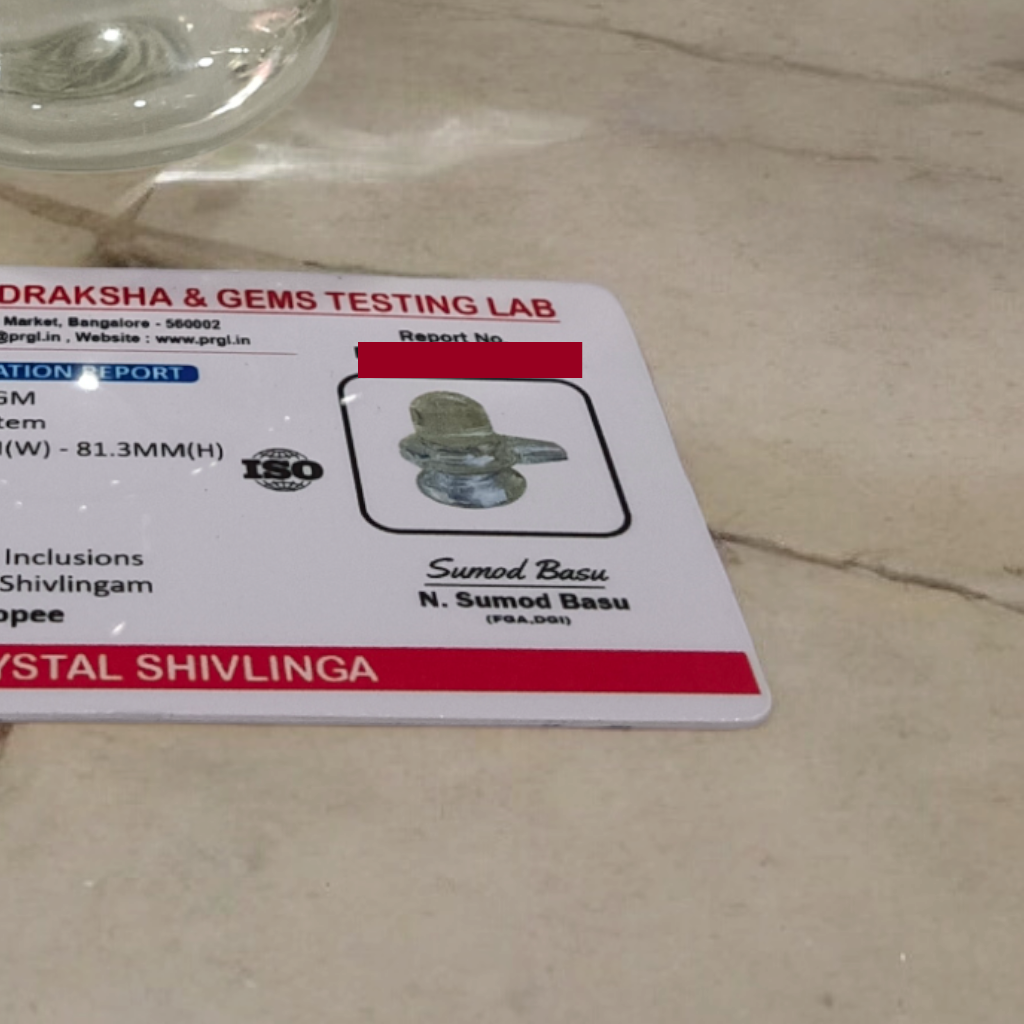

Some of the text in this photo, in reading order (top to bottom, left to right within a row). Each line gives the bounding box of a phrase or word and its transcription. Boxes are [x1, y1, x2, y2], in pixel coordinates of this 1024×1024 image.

[184, 287, 208, 308] &
[217, 288, 318, 311] GEMS
[325, 291, 477, 315] TESTING
[488, 298, 556, 318] LAB
[4, 316, 62, 328] Market,
[68, 317, 150, 329] Bangalore
[166, 319, 220, 329] 560002
[75, 332, 140, 343] Website
[156, 335, 251, 346] www.prgl.in
[399, 330, 469, 342] Report
[82, 365, 184, 380] REPORT
[76, 440, 224, 461] 81.3MM(H)
[242, 459, 324, 481] ISO
[5, 548, 143, 566] Inclusions
[426, 557, 609, 582] Sumod Basu
[0, 575, 153, 596] Shivlingam
[418, 591, 630, 610] N. Sumod Basu
[135, 653, 378, 683] SHIVLINGA
